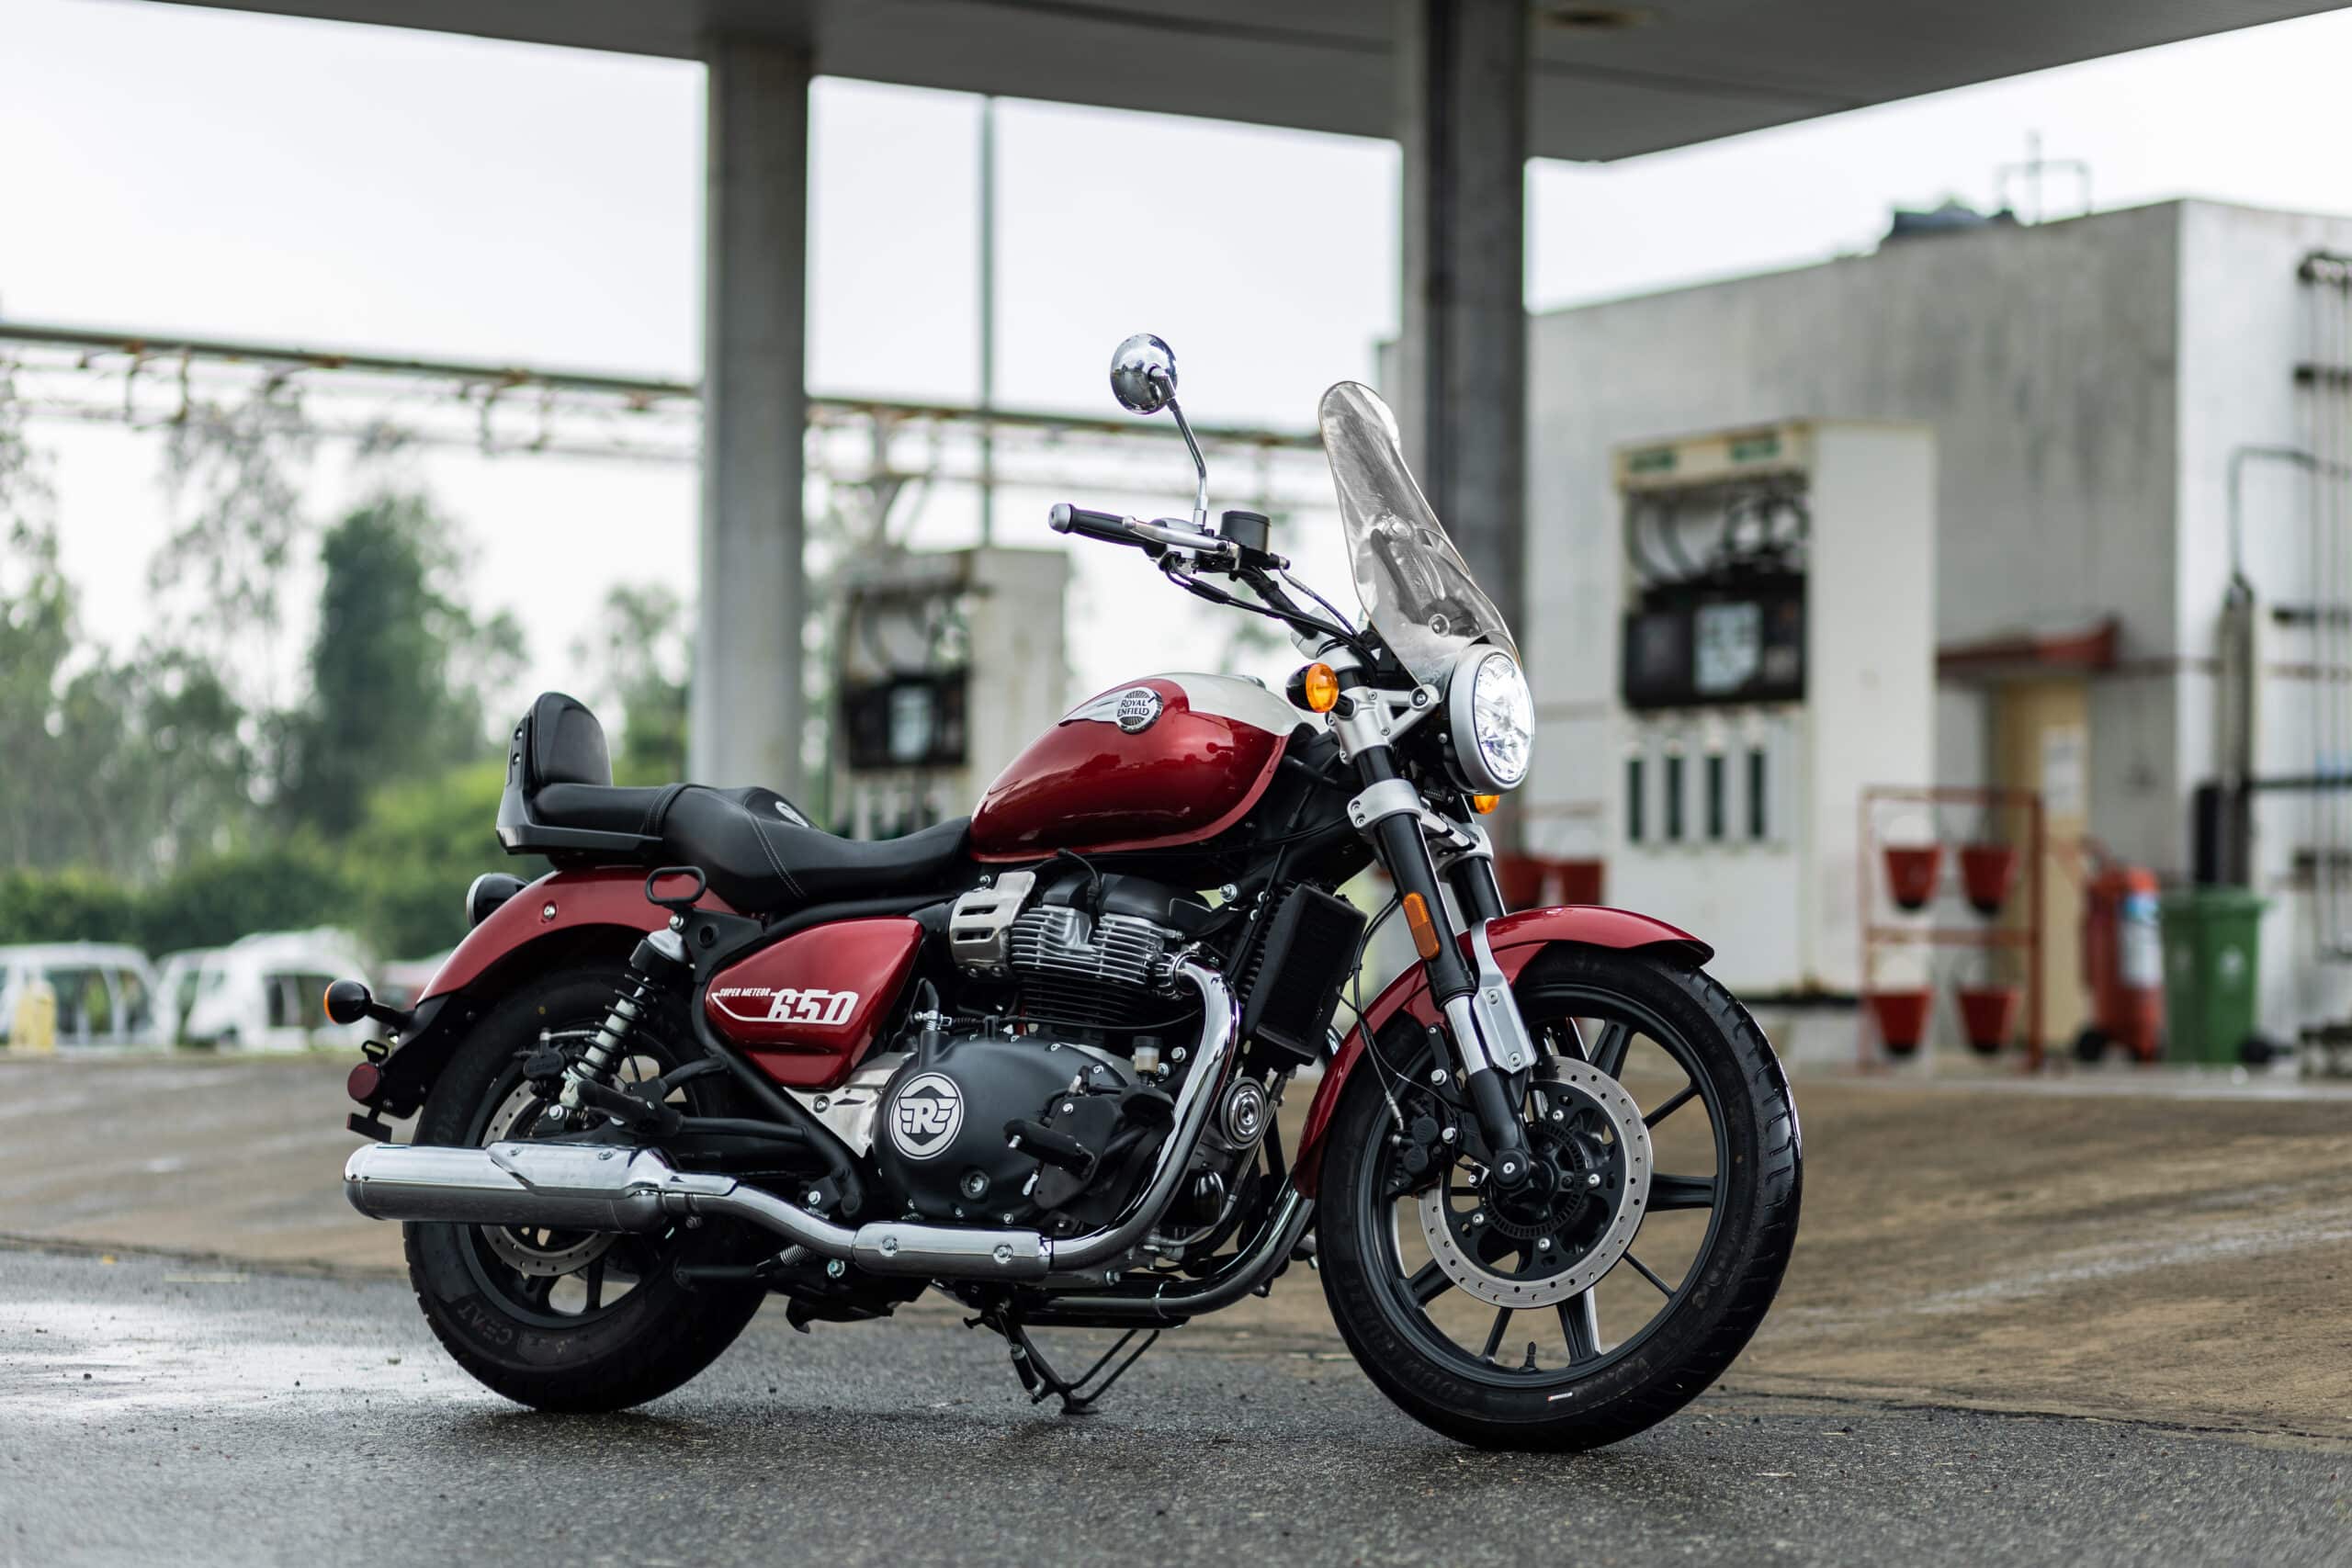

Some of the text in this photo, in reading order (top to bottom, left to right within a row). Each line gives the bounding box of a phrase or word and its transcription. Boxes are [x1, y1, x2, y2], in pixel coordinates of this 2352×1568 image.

[1117, 707, 1149, 716] ENFIELD
[1121, 699, 1147, 708] ROYAL
[719, 987, 858, 1026] SUPER METEOR 650
[456, 1302, 512, 1344] CEAT
